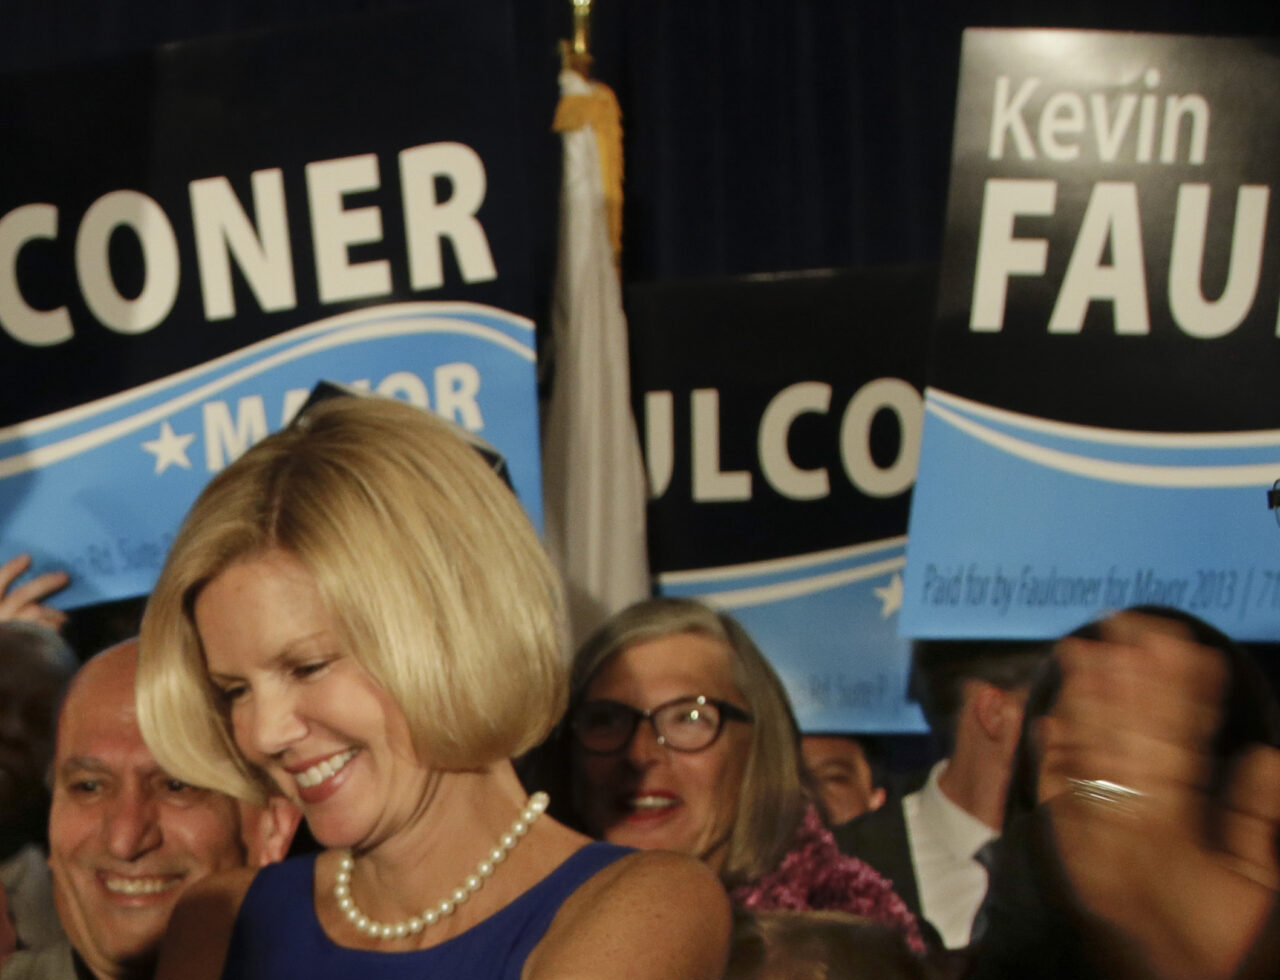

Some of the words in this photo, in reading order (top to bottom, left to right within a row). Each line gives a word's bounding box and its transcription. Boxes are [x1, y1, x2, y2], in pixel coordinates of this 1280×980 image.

[987, 68, 1212, 166] Kevin
[968, 178, 1280, 339] FAU
[921, 563, 964, 607] Paid
